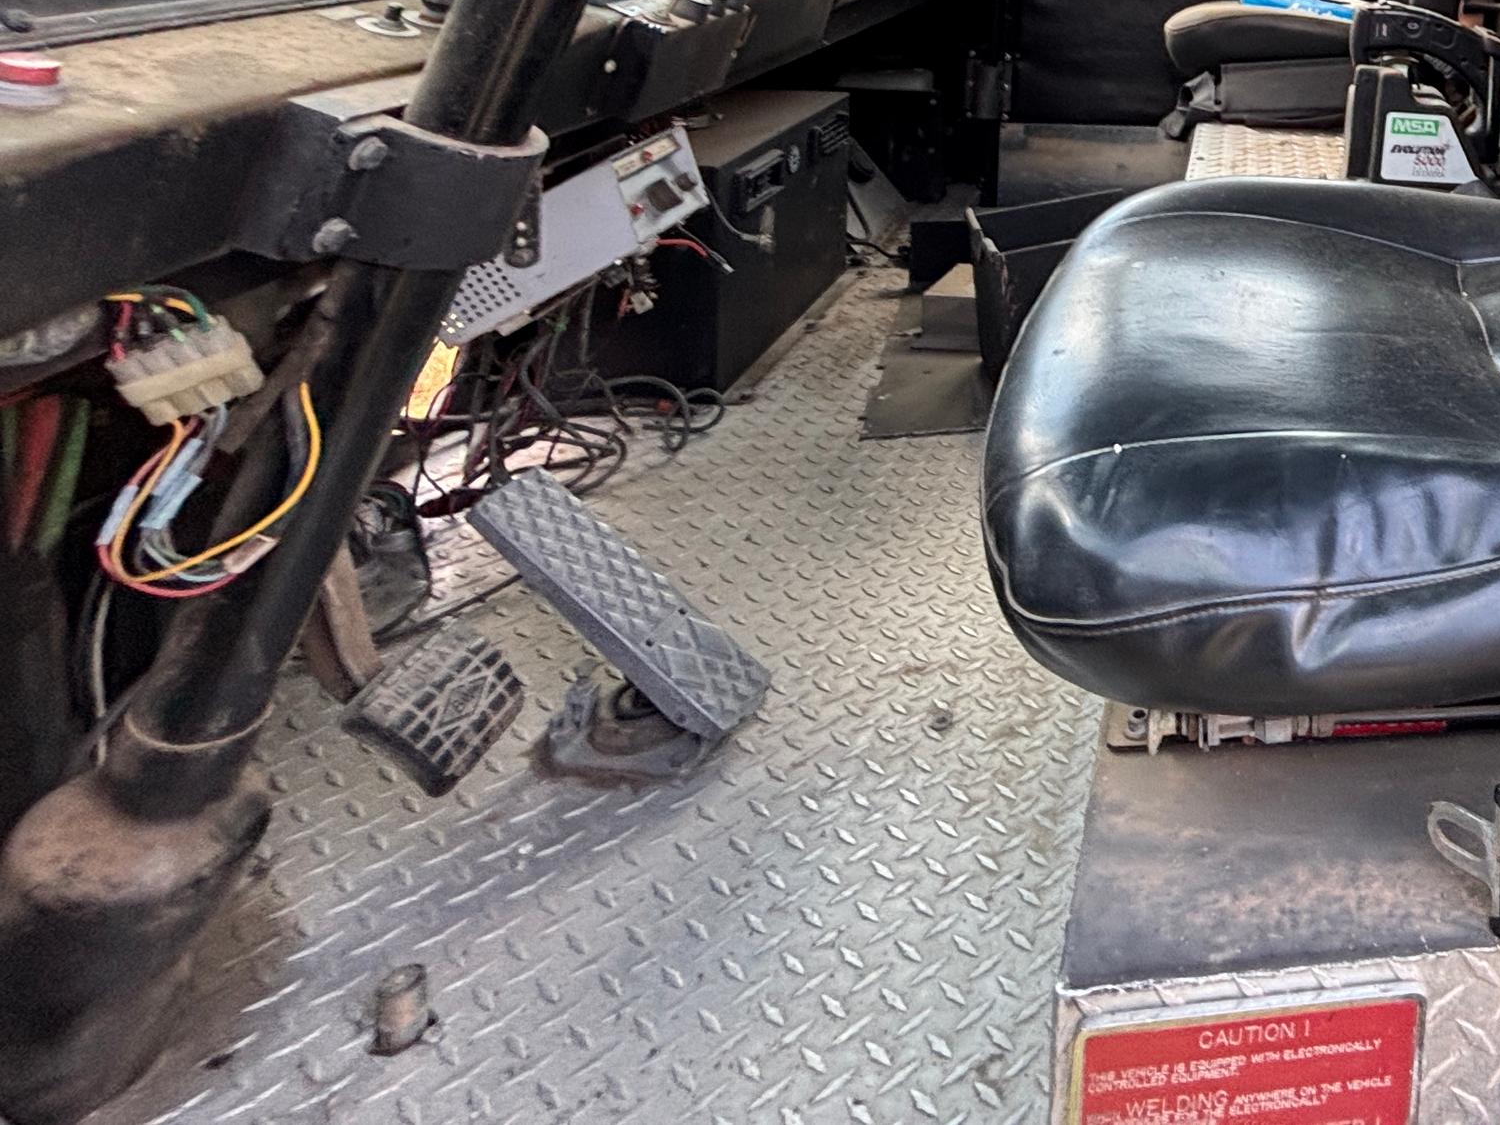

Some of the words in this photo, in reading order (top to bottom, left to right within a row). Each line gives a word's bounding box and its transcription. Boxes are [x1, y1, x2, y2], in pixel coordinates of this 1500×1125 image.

[1393, 118, 1437, 134] MSA
[1199, 1021, 1296, 1049] CAUTION
[1121, 1064, 1170, 1078] VEHICLE
[1174, 1062, 1186, 1073] IS
[1190, 1055, 1247, 1071] EQUIPPED
[1251, 1051, 1281, 1063] WITH
[1283, 1038, 1382, 1060] ELECTRONICALLY
[1088, 1074, 1168, 1093] CONTROLLED
[1126, 1090, 1229, 1117] WELDING
[1234, 1087, 1297, 1104] ANYWHERE
[1300, 1086, 1317, 1096] ON
[1320, 1082, 1343, 1093] THE
[1346, 1075, 1392, 1091] VEHICLE
[1229, 1093, 1329, 1116] ELECTRONICALLY
